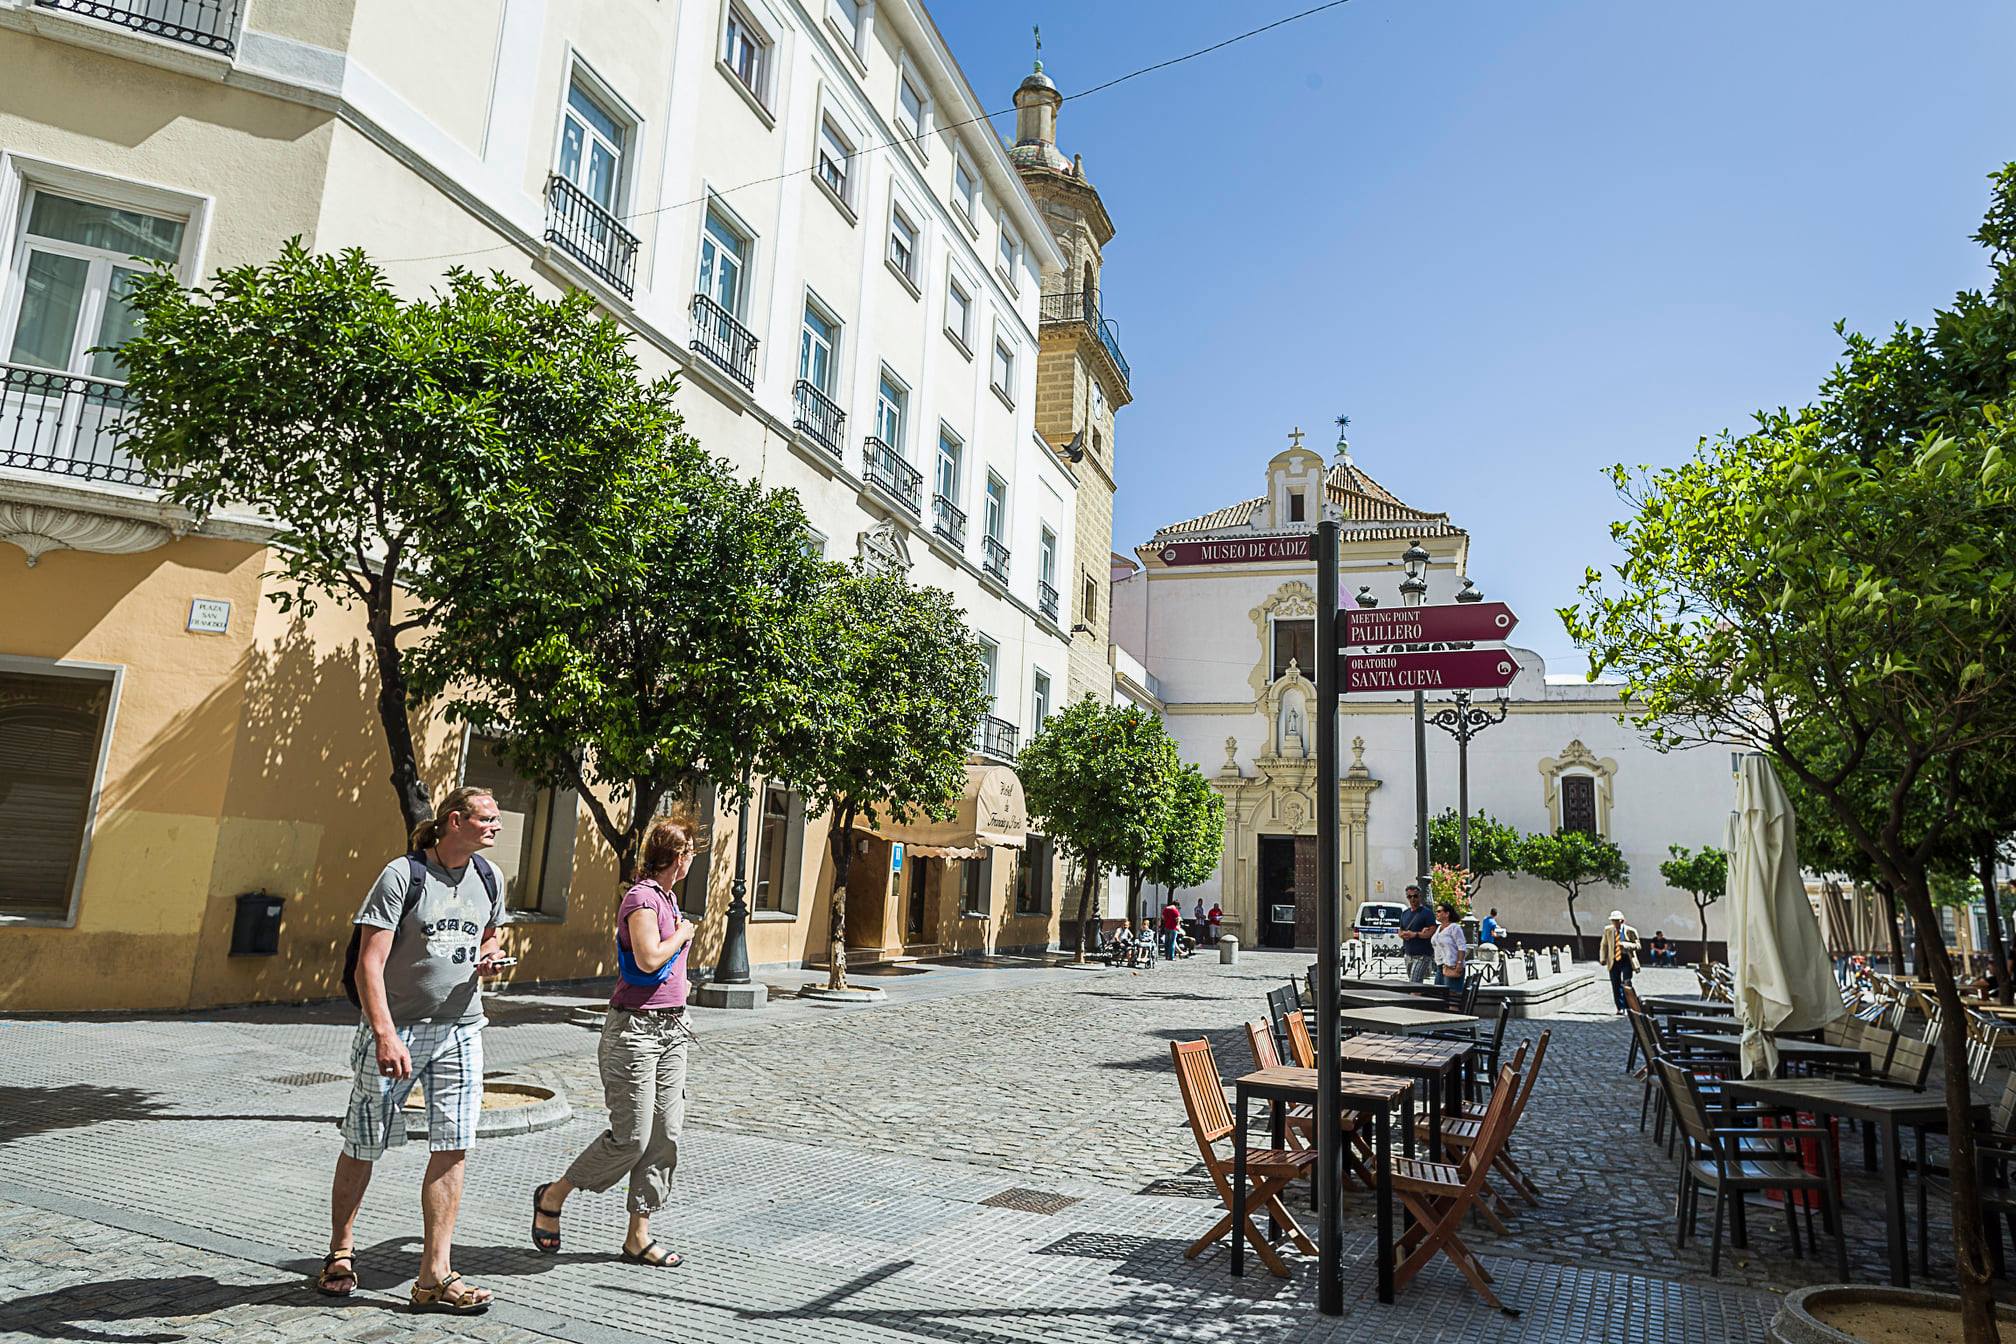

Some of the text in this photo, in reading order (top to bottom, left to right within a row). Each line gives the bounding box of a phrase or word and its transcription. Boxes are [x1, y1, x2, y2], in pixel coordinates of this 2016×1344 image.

[1201, 539, 1307, 560] MUSEO DE CÁDIZ
[1351, 611, 1420, 624] MEETING POINT
[1351, 624, 1422, 641] PALILLERO
[1351, 658, 1397, 669] ORATORIO
[1351, 669, 1443, 687] SANTA CUEVA
